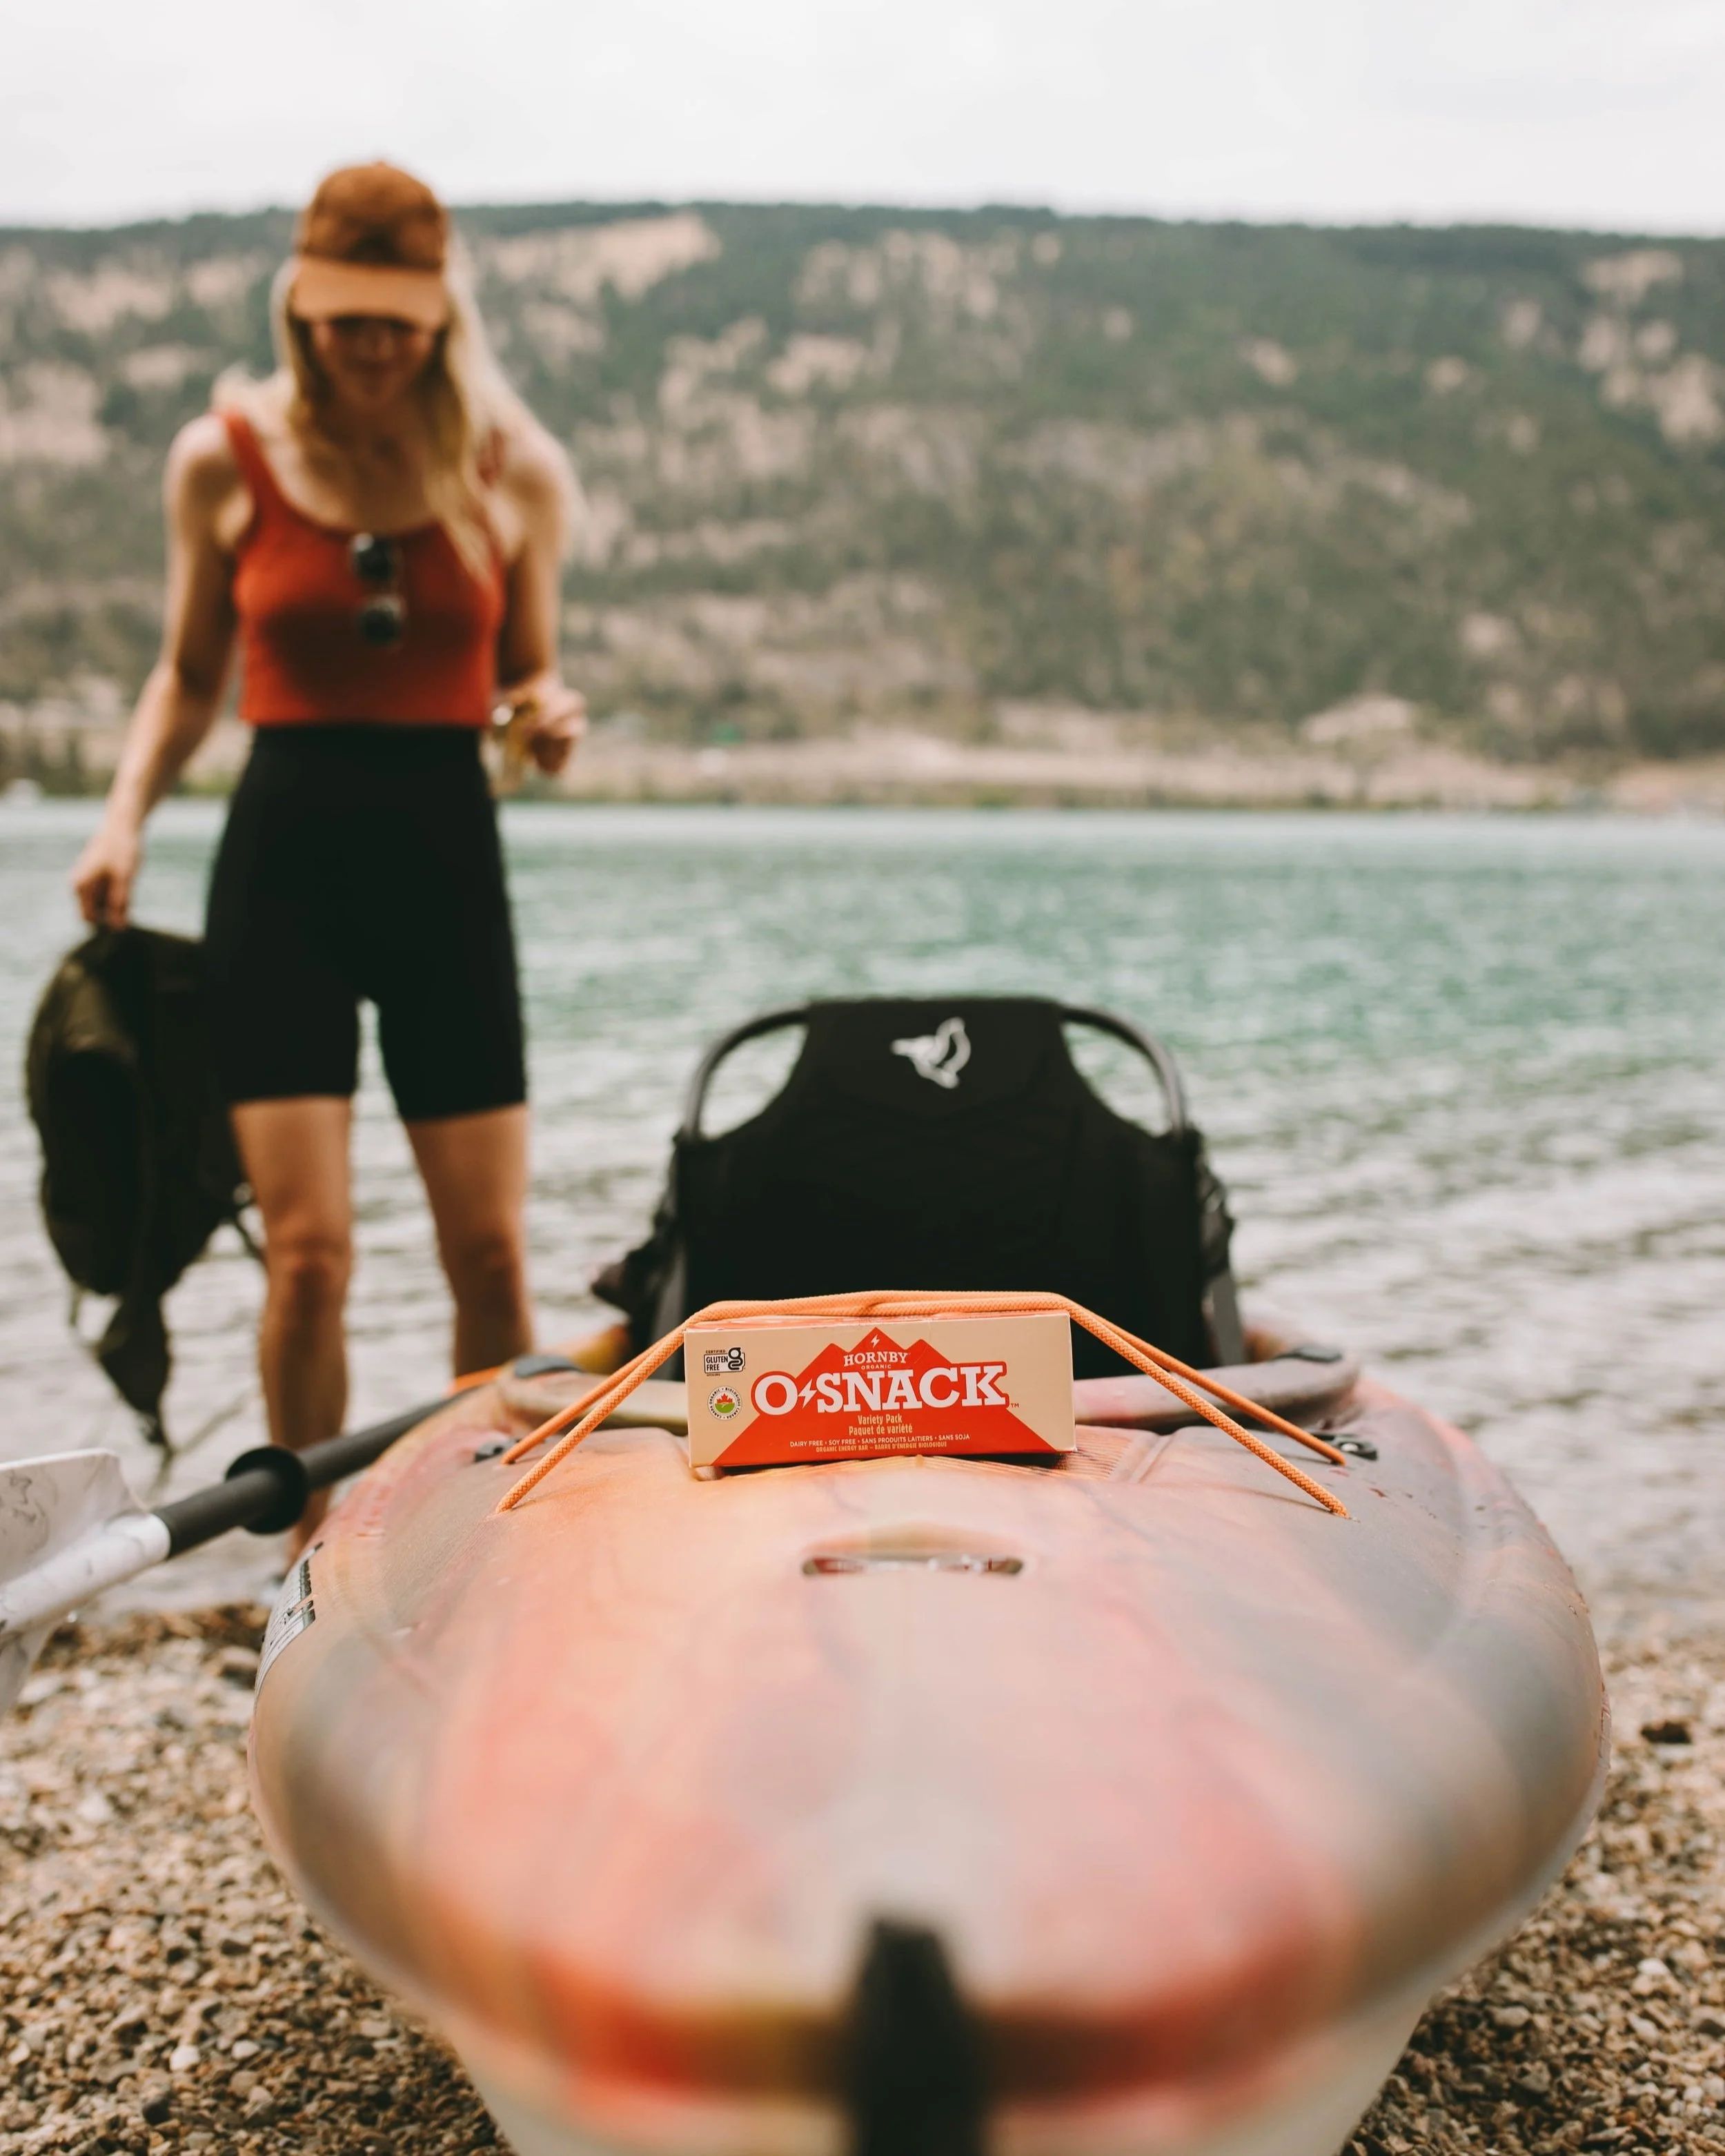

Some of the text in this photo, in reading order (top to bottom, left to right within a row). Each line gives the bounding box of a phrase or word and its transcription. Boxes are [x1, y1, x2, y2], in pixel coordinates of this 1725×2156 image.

[843, 1351, 908, 1366] HORNBY
[858, 1413, 903, 1425] Variety Pack
[849, 1424, 913, 1437] Paquet de variété
